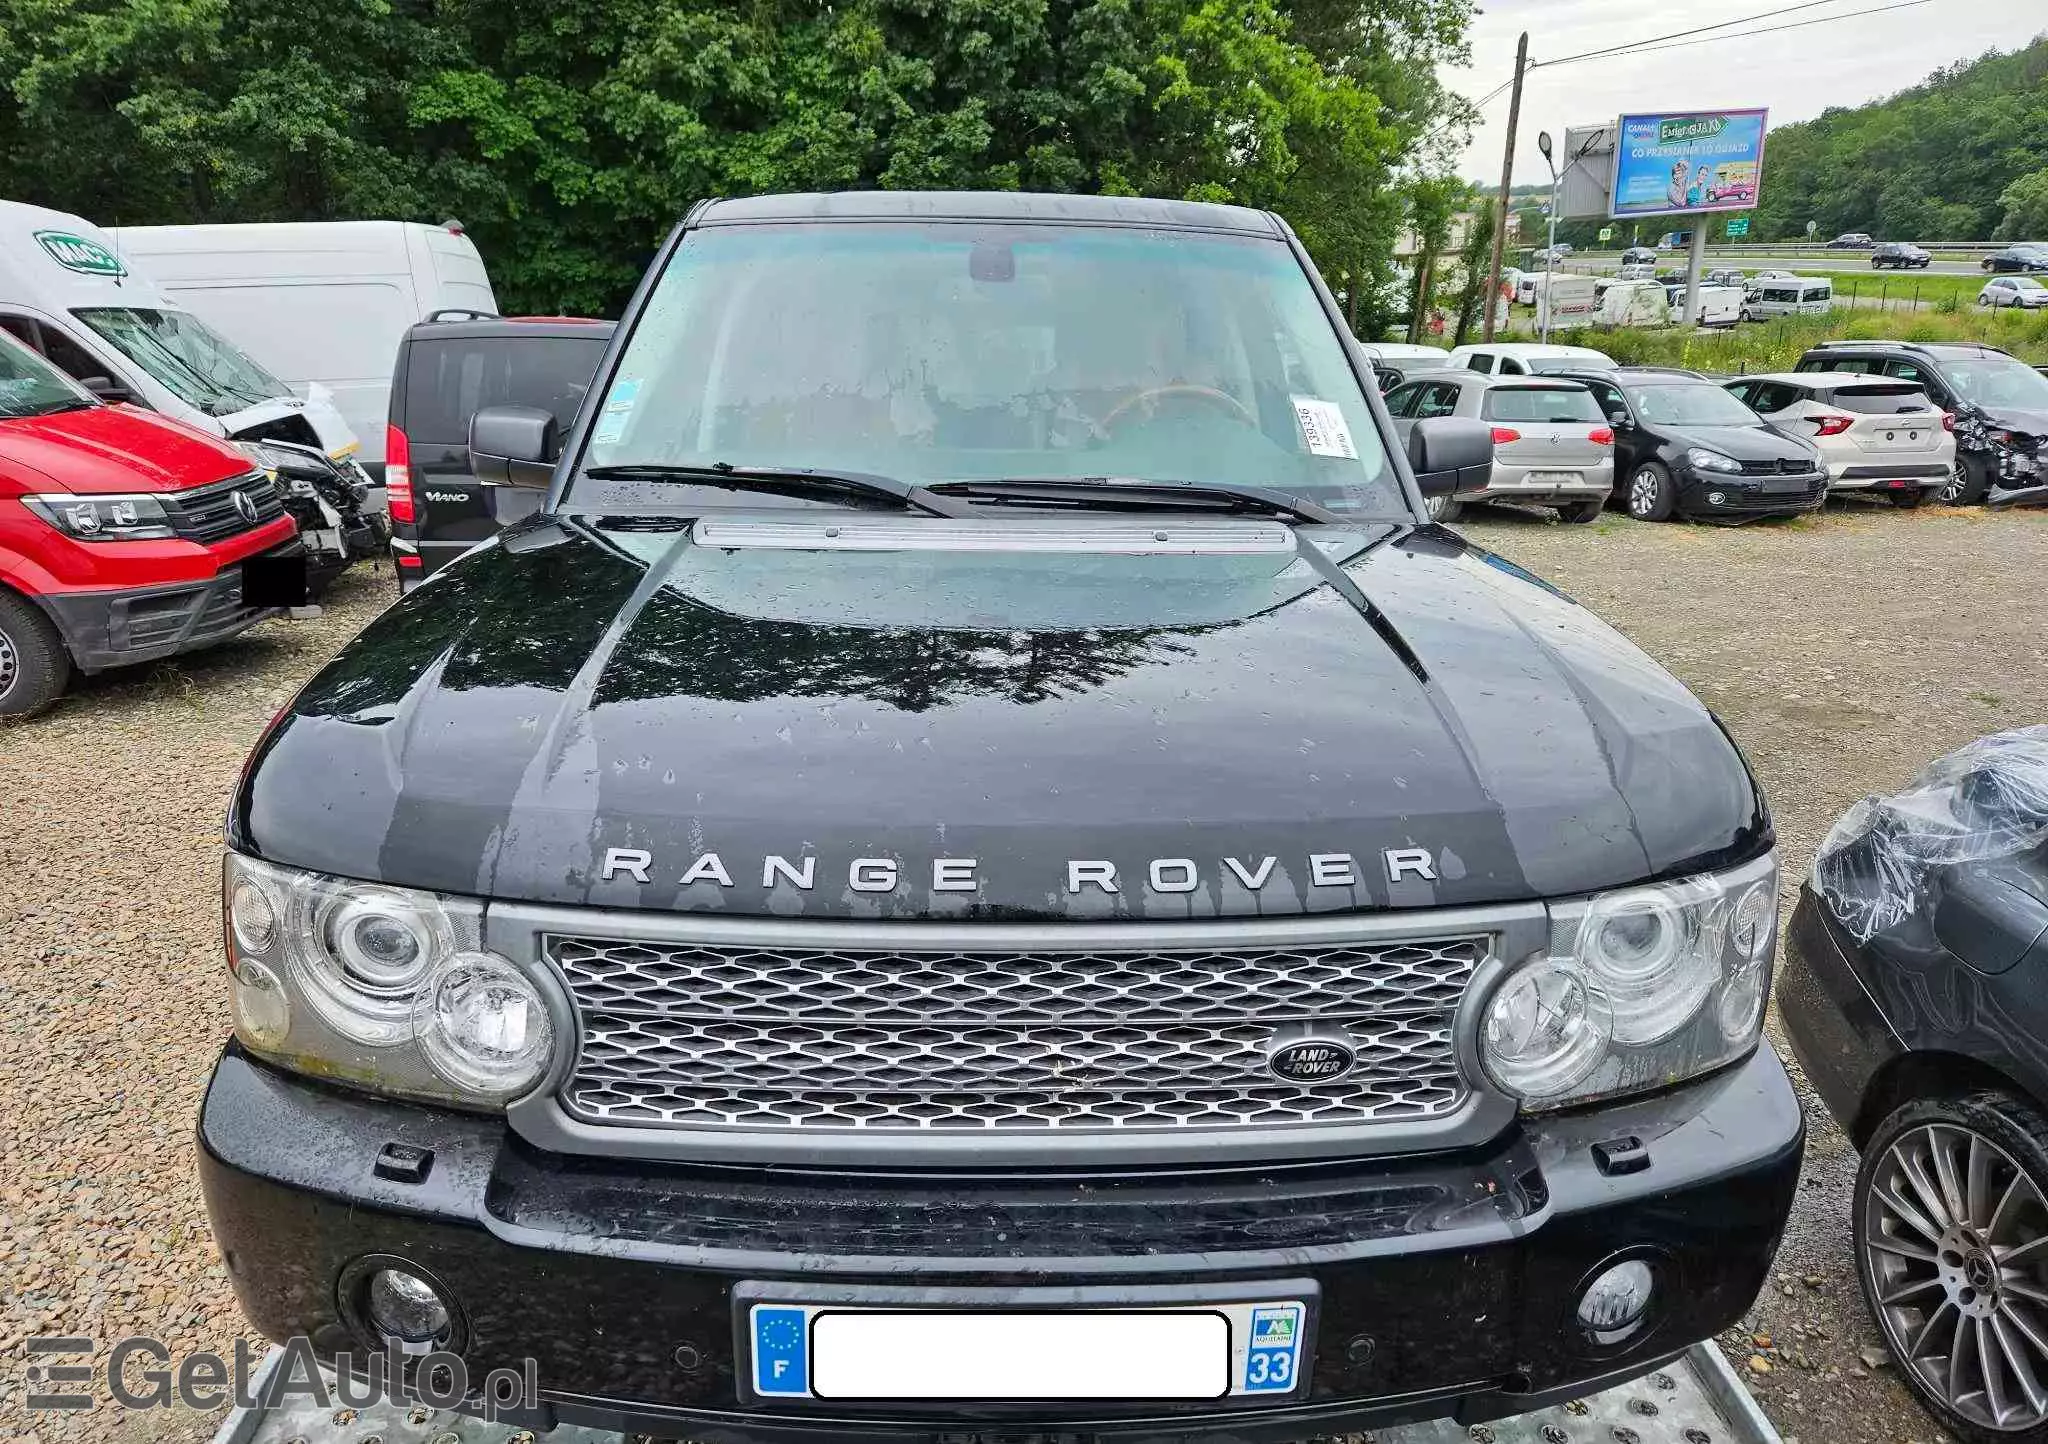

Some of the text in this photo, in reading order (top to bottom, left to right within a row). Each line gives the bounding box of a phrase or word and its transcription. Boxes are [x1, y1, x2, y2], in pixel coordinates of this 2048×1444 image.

[425, 491, 469, 502] VIANO
[601, 847, 1438, 893] RANGE ROVER
[1288, 1049, 1329, 1062] LAND
[1291, 1061, 1340, 1074] ROVER
[774, 1359, 790, 1378] F
[1248, 1351, 1291, 1384] 33
